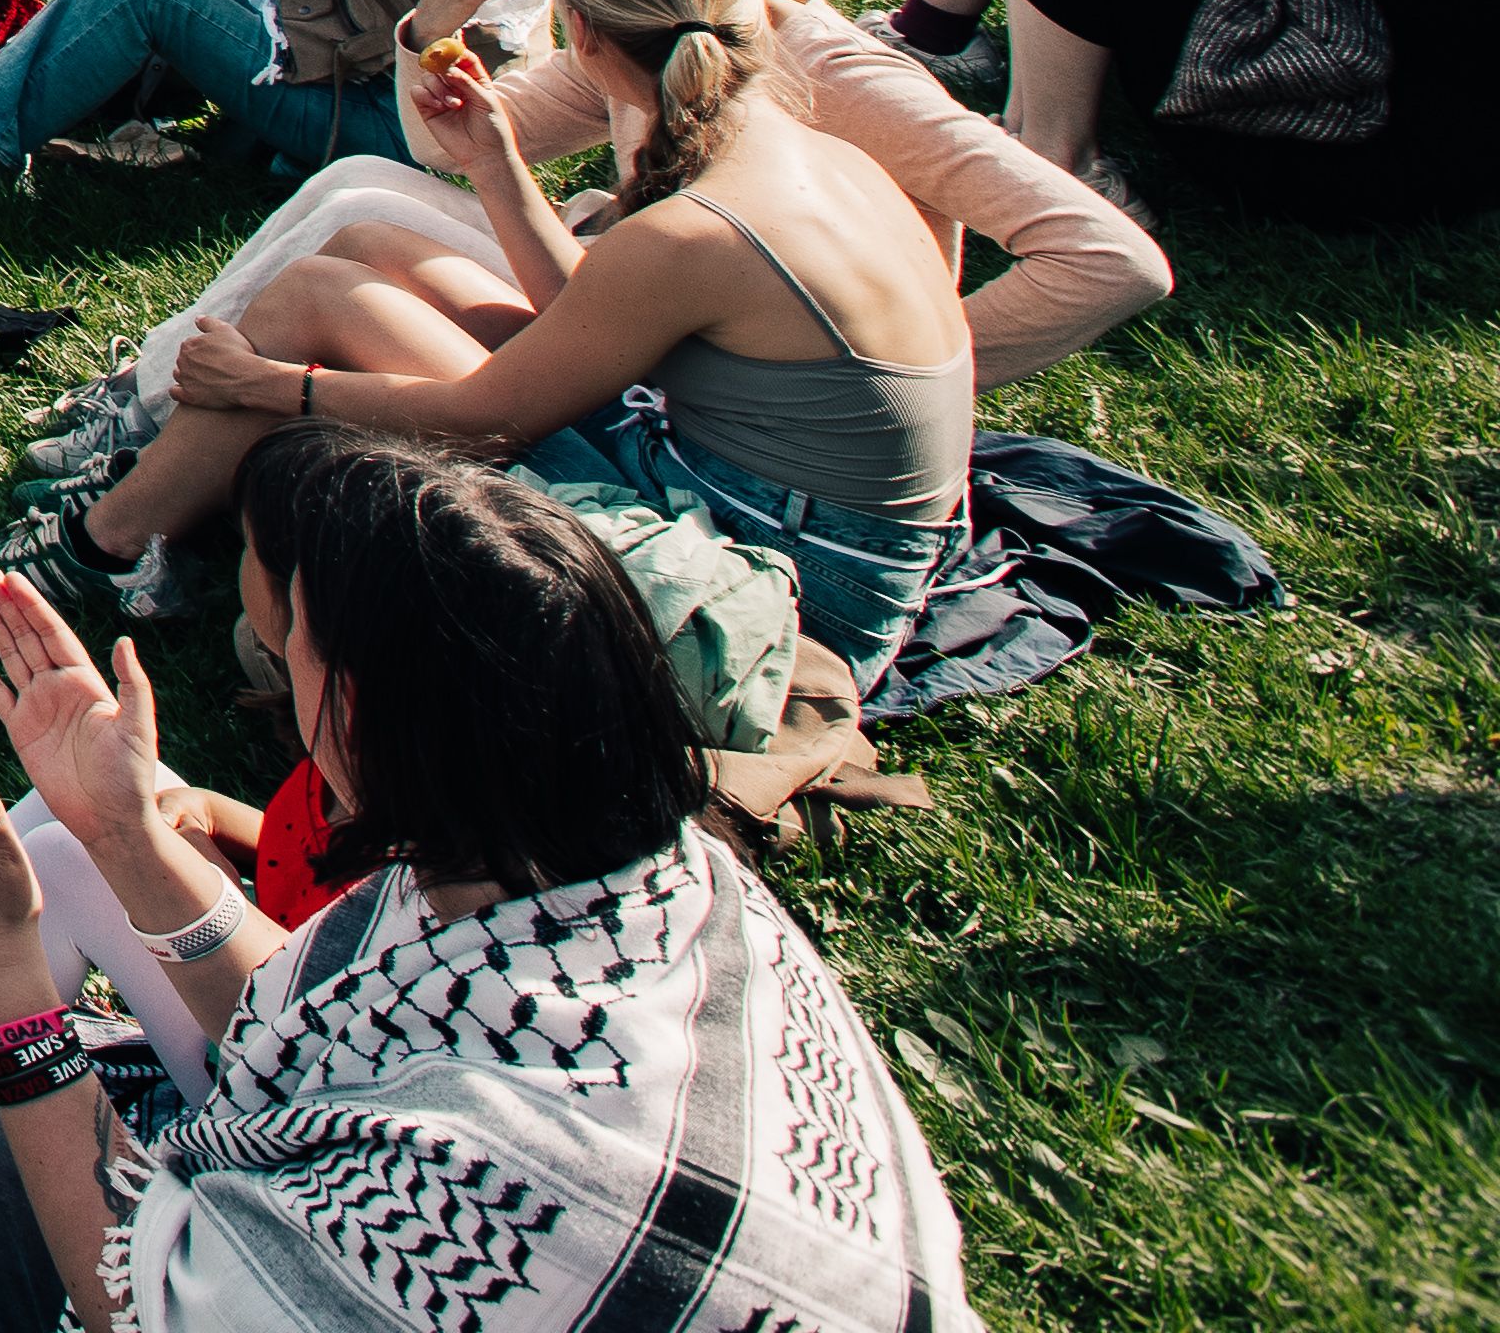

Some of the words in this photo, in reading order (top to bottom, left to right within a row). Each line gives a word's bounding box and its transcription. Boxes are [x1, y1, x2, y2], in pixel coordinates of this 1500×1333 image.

[4, 1018, 54, 1044] GAZA
[14, 1033, 65, 1067] SAVE
[48, 1051, 89, 1084] SAVE
